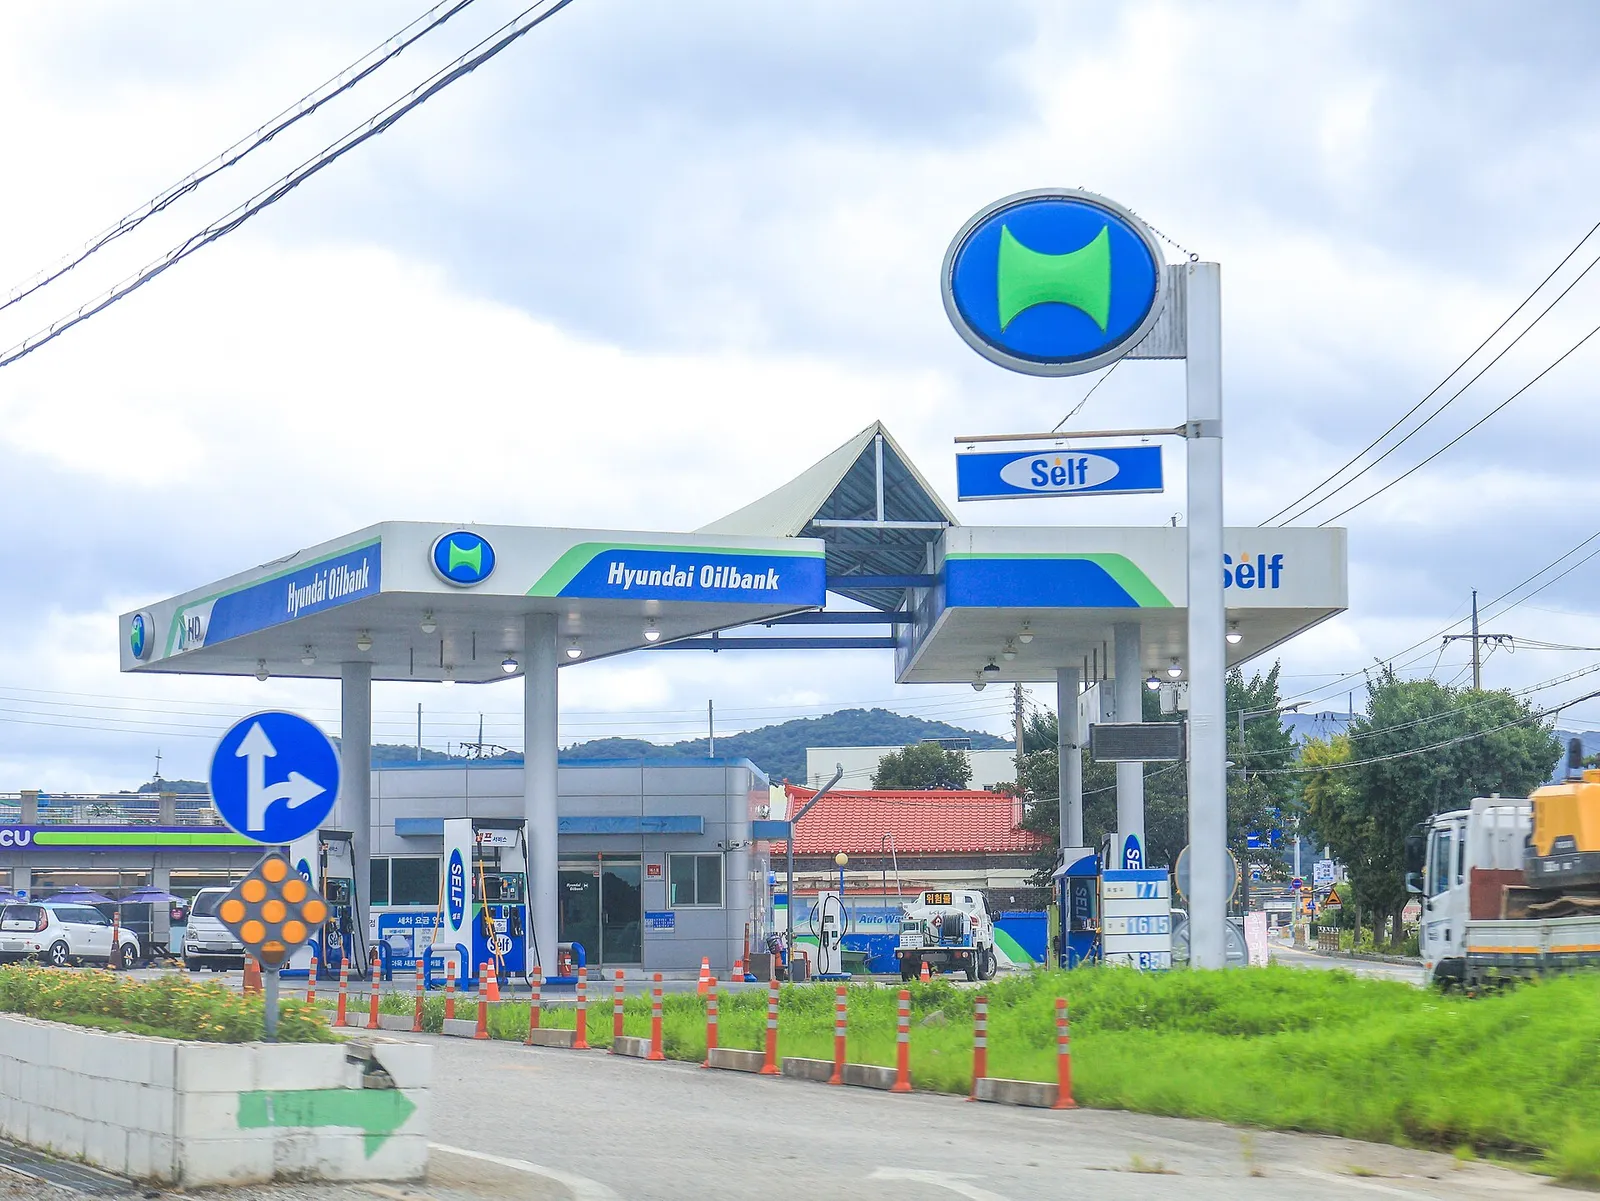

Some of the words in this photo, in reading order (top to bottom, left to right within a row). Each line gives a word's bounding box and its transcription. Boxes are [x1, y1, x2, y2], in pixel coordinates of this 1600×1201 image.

[1031, 458, 1088, 487] Self
[287, 570, 327, 617] Hyundai
[328, 557, 369, 600] Oilbank
[607, 562, 695, 590] Hyundai
[700, 565, 780, 590] Oilbank
[188, 616, 200, 641] HD
[0, 829, 30, 846] CU
[452, 863, 462, 908] SELF
[926, 893, 952, 904] 위험물
[860, 914, 883, 924] Auto
[1129, 917, 1168, 933] 1615
